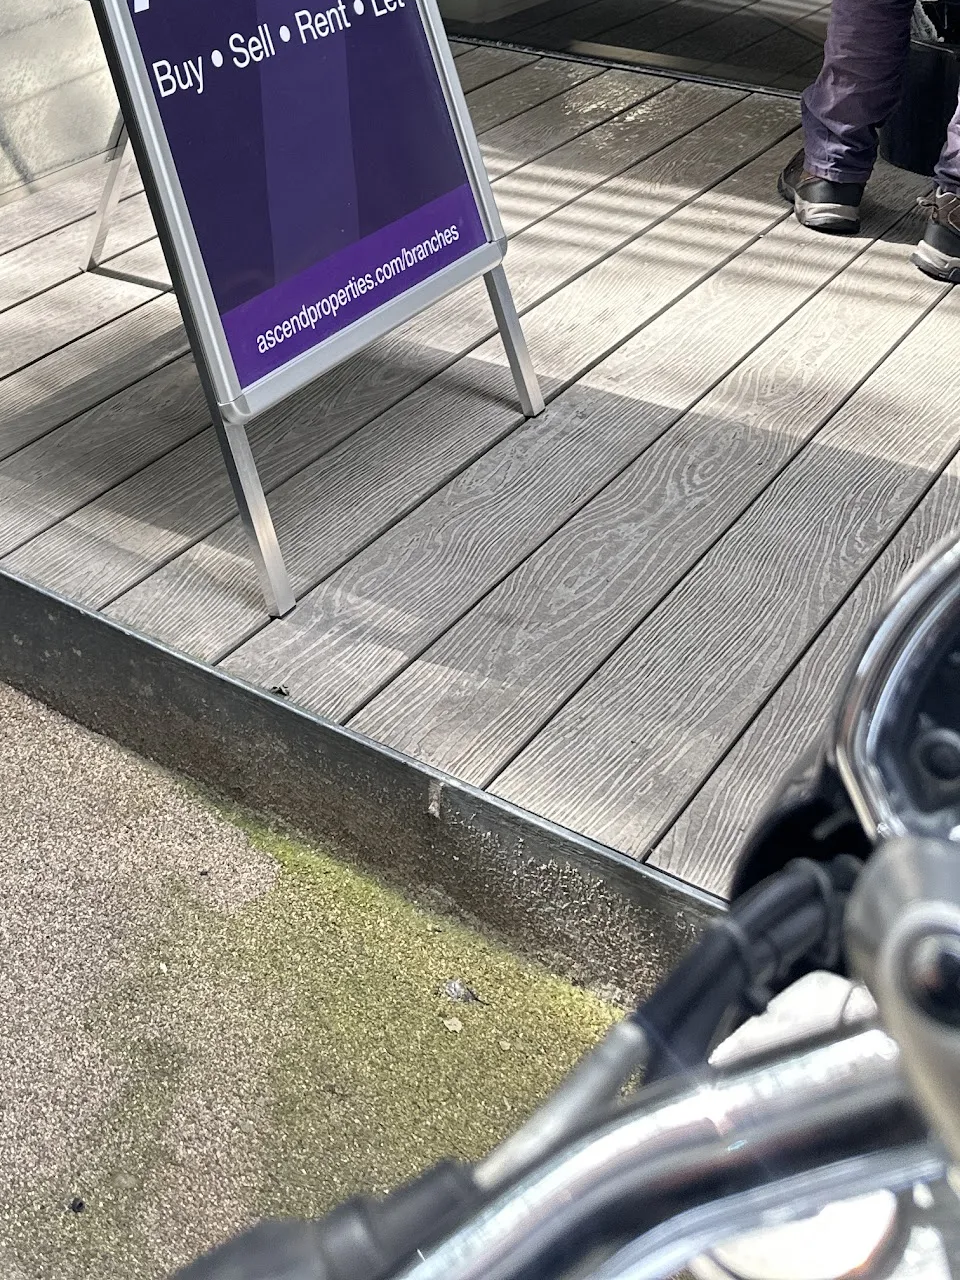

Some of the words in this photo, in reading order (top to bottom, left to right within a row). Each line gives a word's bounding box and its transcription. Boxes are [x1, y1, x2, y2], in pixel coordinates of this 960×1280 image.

[152, 56, 204, 98] Buy
[228, 23, 276, 68] Sell
[294, 0, 351, 44] Rent
[256, 223, 460, 355] ascendproperties.com/branches
